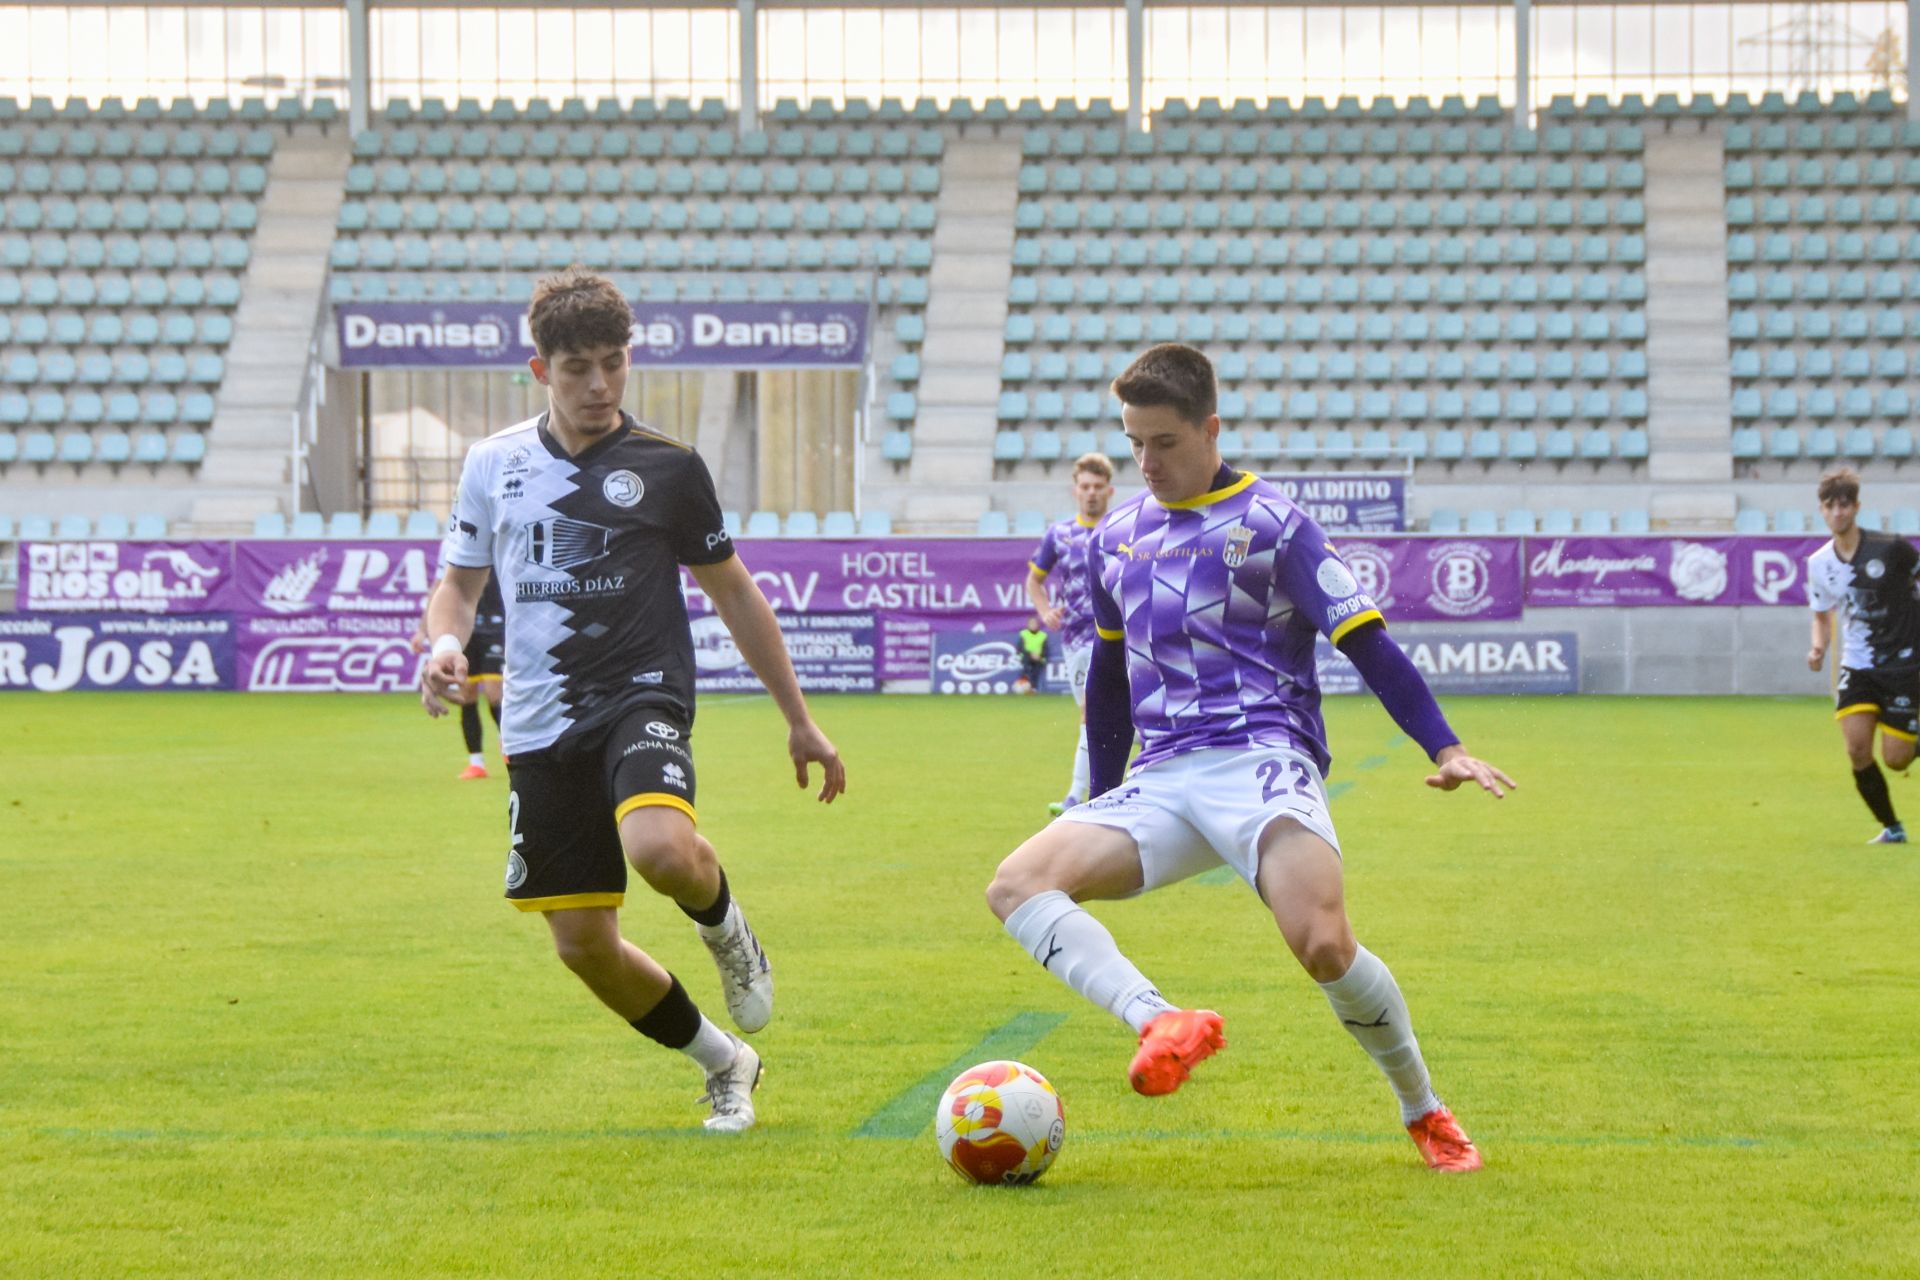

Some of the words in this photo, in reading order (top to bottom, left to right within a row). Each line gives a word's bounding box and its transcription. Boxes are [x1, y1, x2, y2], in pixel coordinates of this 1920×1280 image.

[344, 310, 499, 347] Danisa
[692, 309, 847, 347] Danisa
[1302, 481, 1391, 499] AUDITIVO
[842, 552, 936, 577] HOTEL
[29, 571, 109, 598] RIOS
[516, 580, 580, 595] HIERROS
[585, 576, 625, 593] DÍAZ
[843, 583, 982, 609] CASTILLA
[1400, 641, 1568, 674] AMBAR
[1256, 760, 1318, 804] 22
